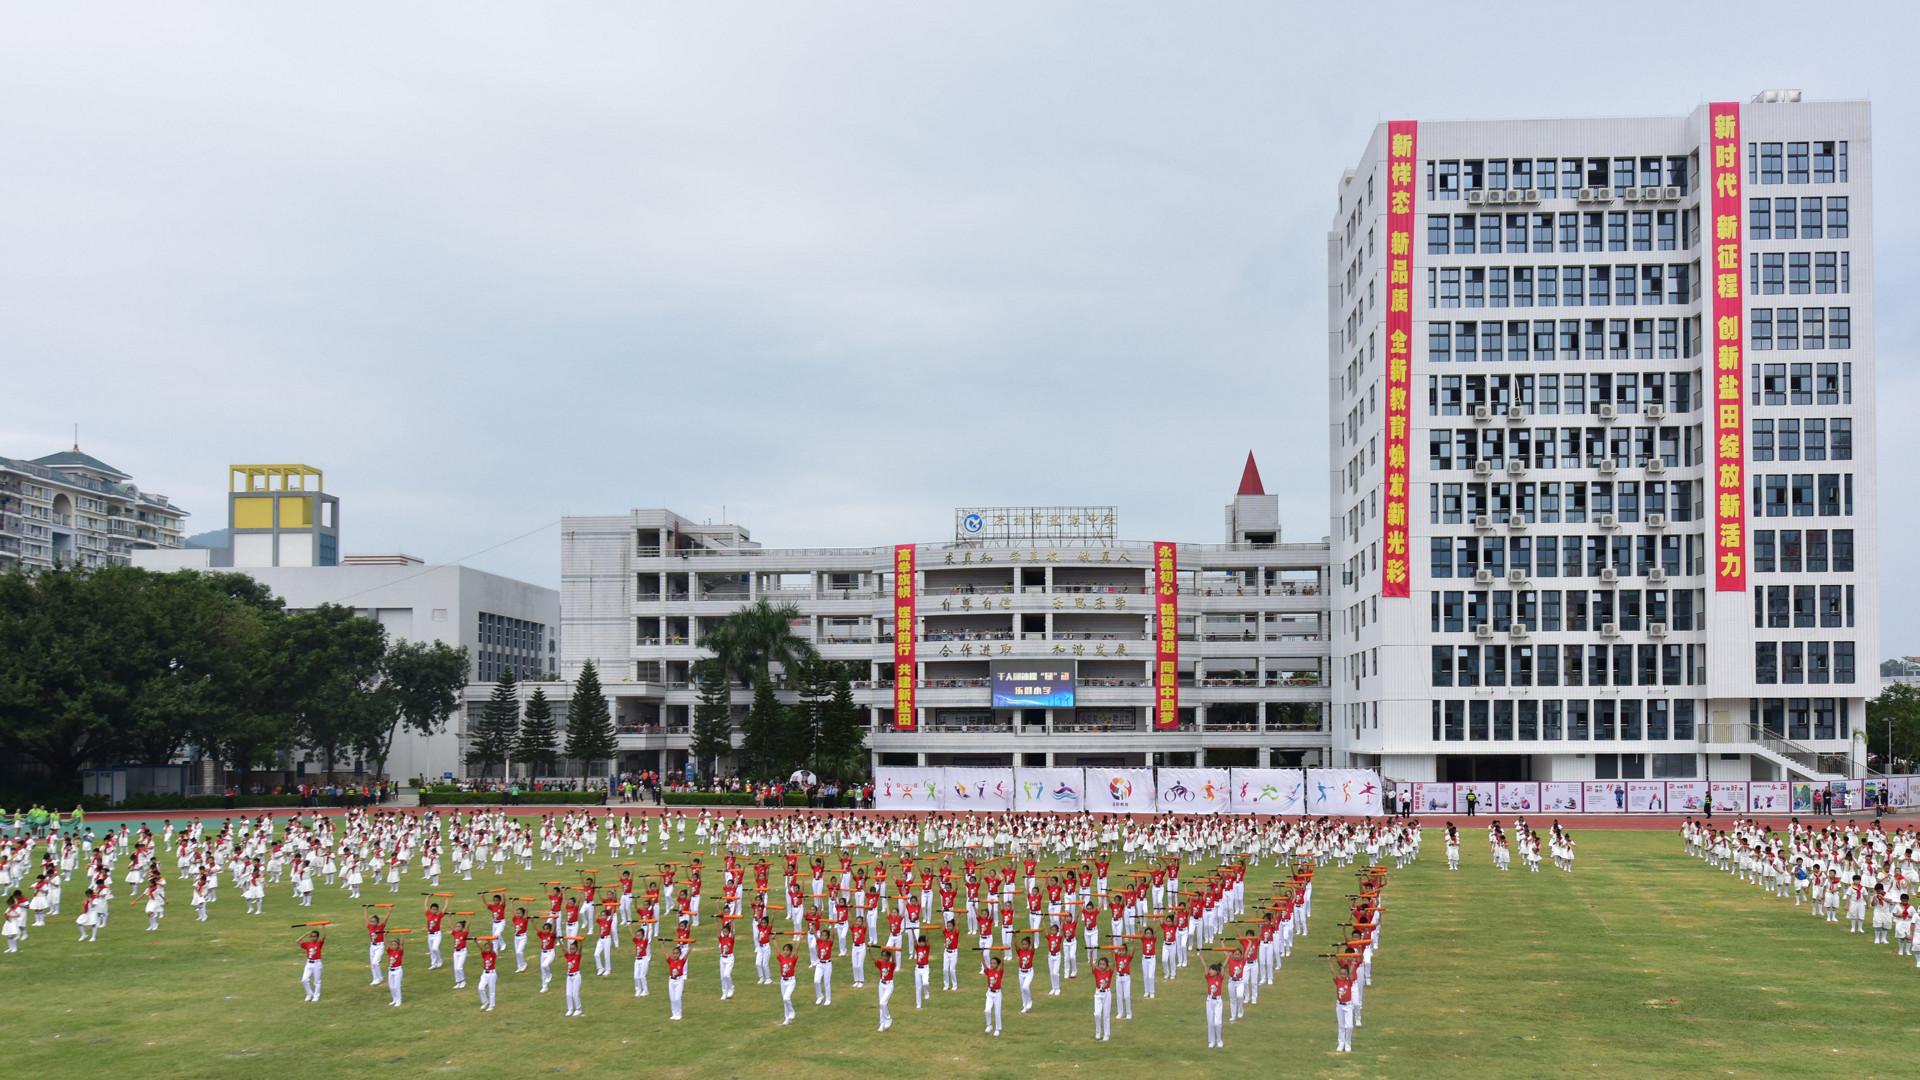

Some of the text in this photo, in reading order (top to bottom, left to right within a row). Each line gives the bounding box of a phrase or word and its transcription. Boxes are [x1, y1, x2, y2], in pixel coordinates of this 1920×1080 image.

[1386, 133, 1412, 583] 新样态 新品质 全新教育焕发新光彩
[1714, 114, 1742, 578] 新时代 新征程 创新盐田绽放新活力
[897, 549, 911, 599] 高举旗帜
[941, 597, 1012, 612] 自尊自信
[939, 643, 1129, 658] 合作进取 和谐发展
[1159, 546, 1175, 724] 永葆初心 砥砺奋进 同圆中国梦
[898, 663, 911, 726] 共建新盐田
